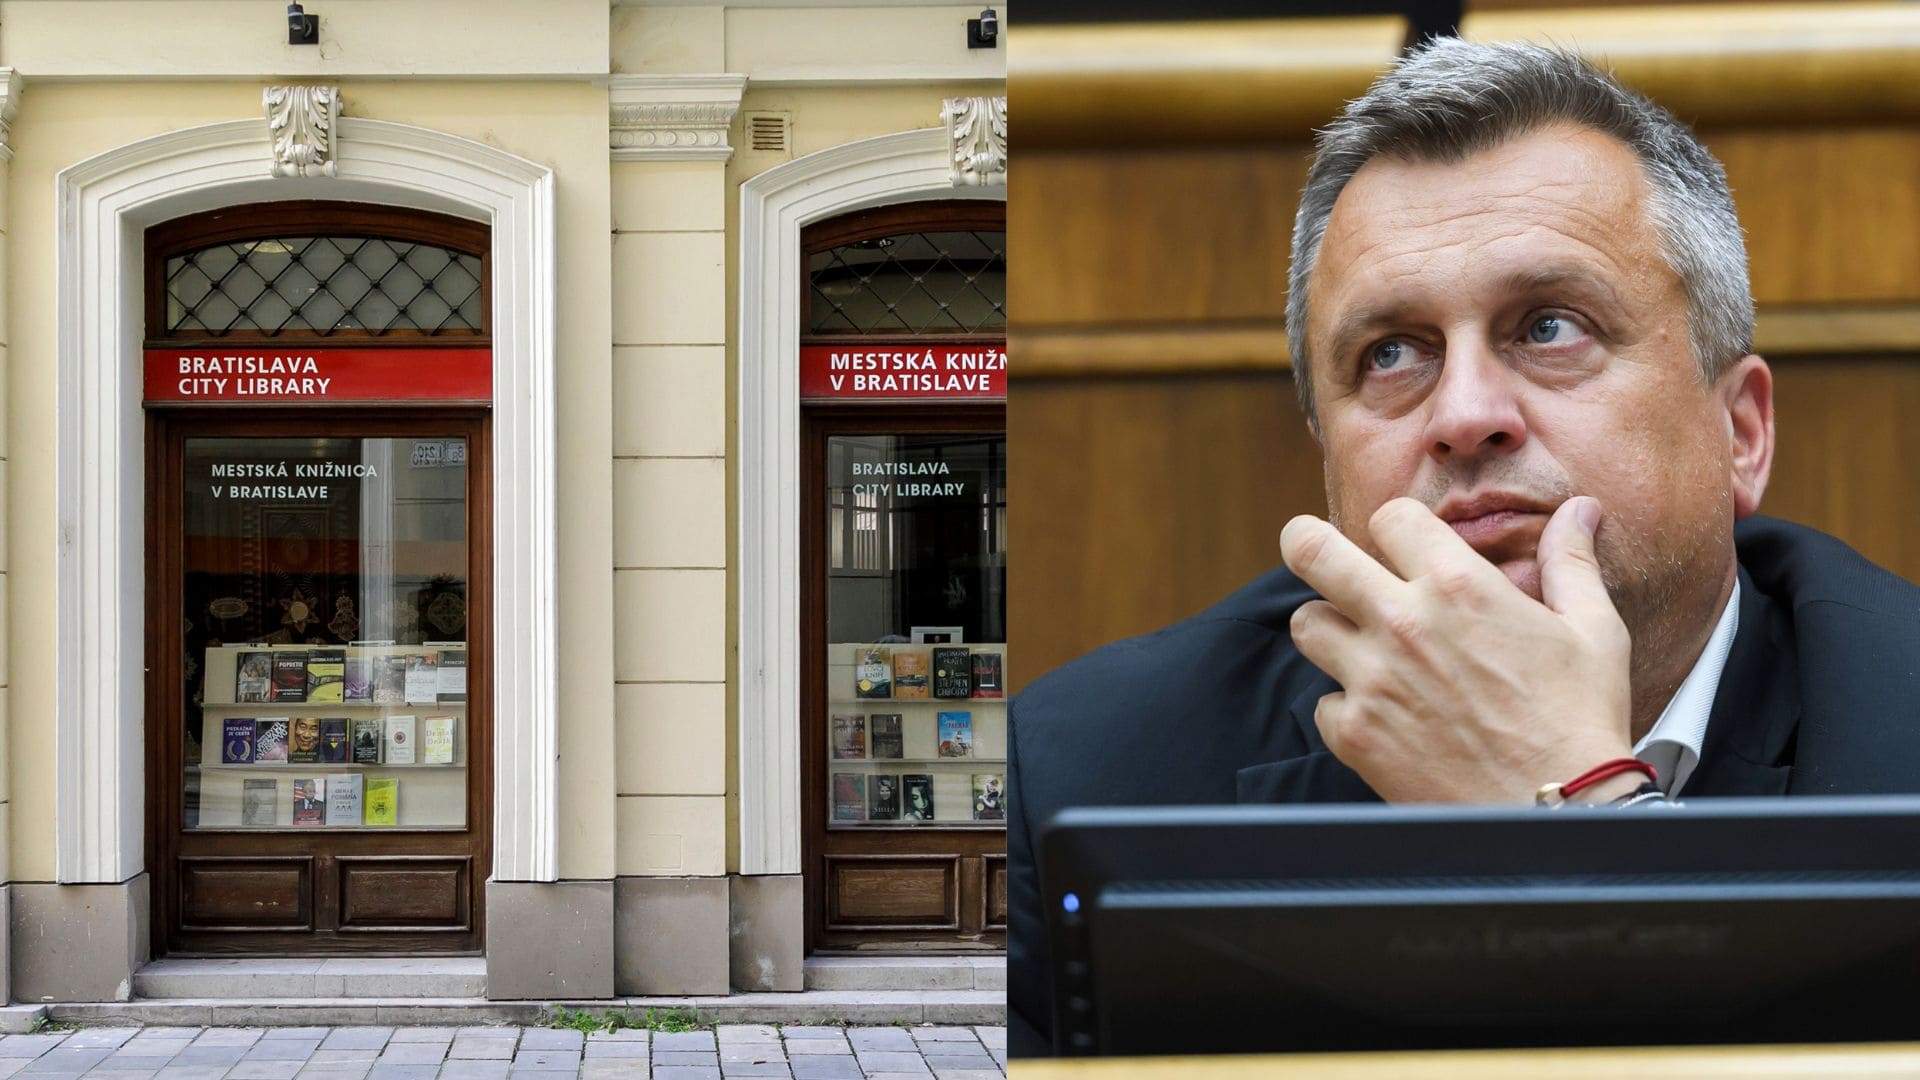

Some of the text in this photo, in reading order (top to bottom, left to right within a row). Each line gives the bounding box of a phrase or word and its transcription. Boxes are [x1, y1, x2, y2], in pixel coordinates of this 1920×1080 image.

[179, 356, 318, 374] BRATISLAVA
[830, 349, 936, 370] MESTSKÁ
[178, 378, 331, 395] CITY LIBRARY
[830, 374, 990, 391] V BRATISLAVE
[212, 461, 378, 477] MESTSKÁ KNIŽNICA
[852, 462, 950, 476] BRATISLAVA
[212, 485, 328, 499] V BRATISLAVE
[852, 483, 965, 497] CITY LIBRARY
